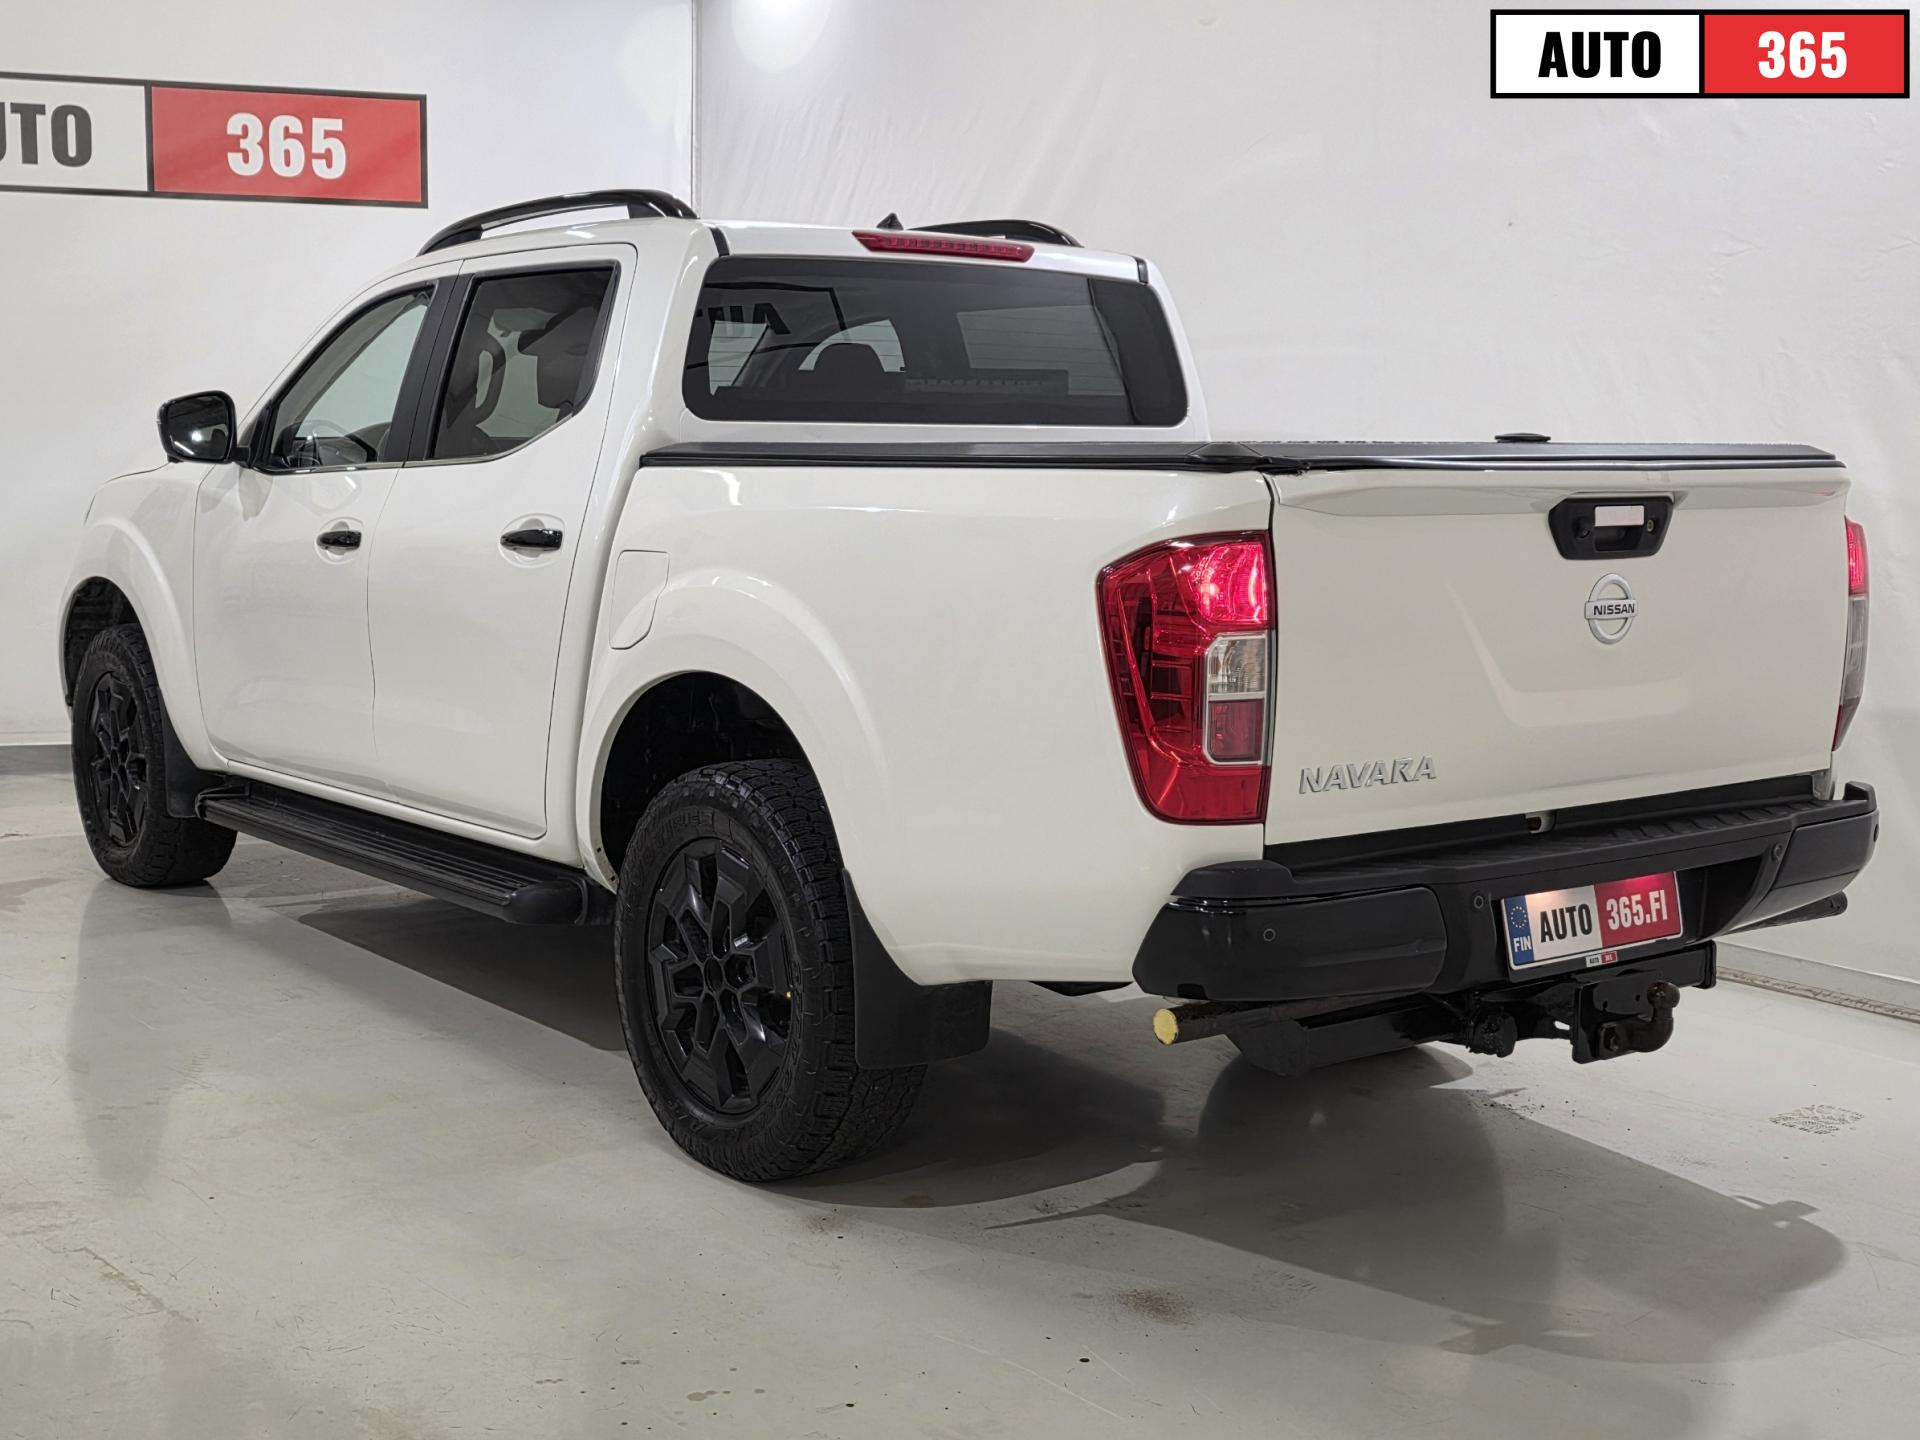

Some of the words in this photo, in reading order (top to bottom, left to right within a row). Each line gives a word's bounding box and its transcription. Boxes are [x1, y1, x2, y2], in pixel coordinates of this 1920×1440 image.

[0, 101, 93, 168] TO
[226, 112, 347, 180] 365
[1593, 603, 1635, 616] NISSAN
[1299, 755, 1437, 795] NAVARA
[1539, 903, 1593, 943] AUTO
[1606, 889, 1668, 931] 365.FI
[1513, 935, 1533, 953] FIN
